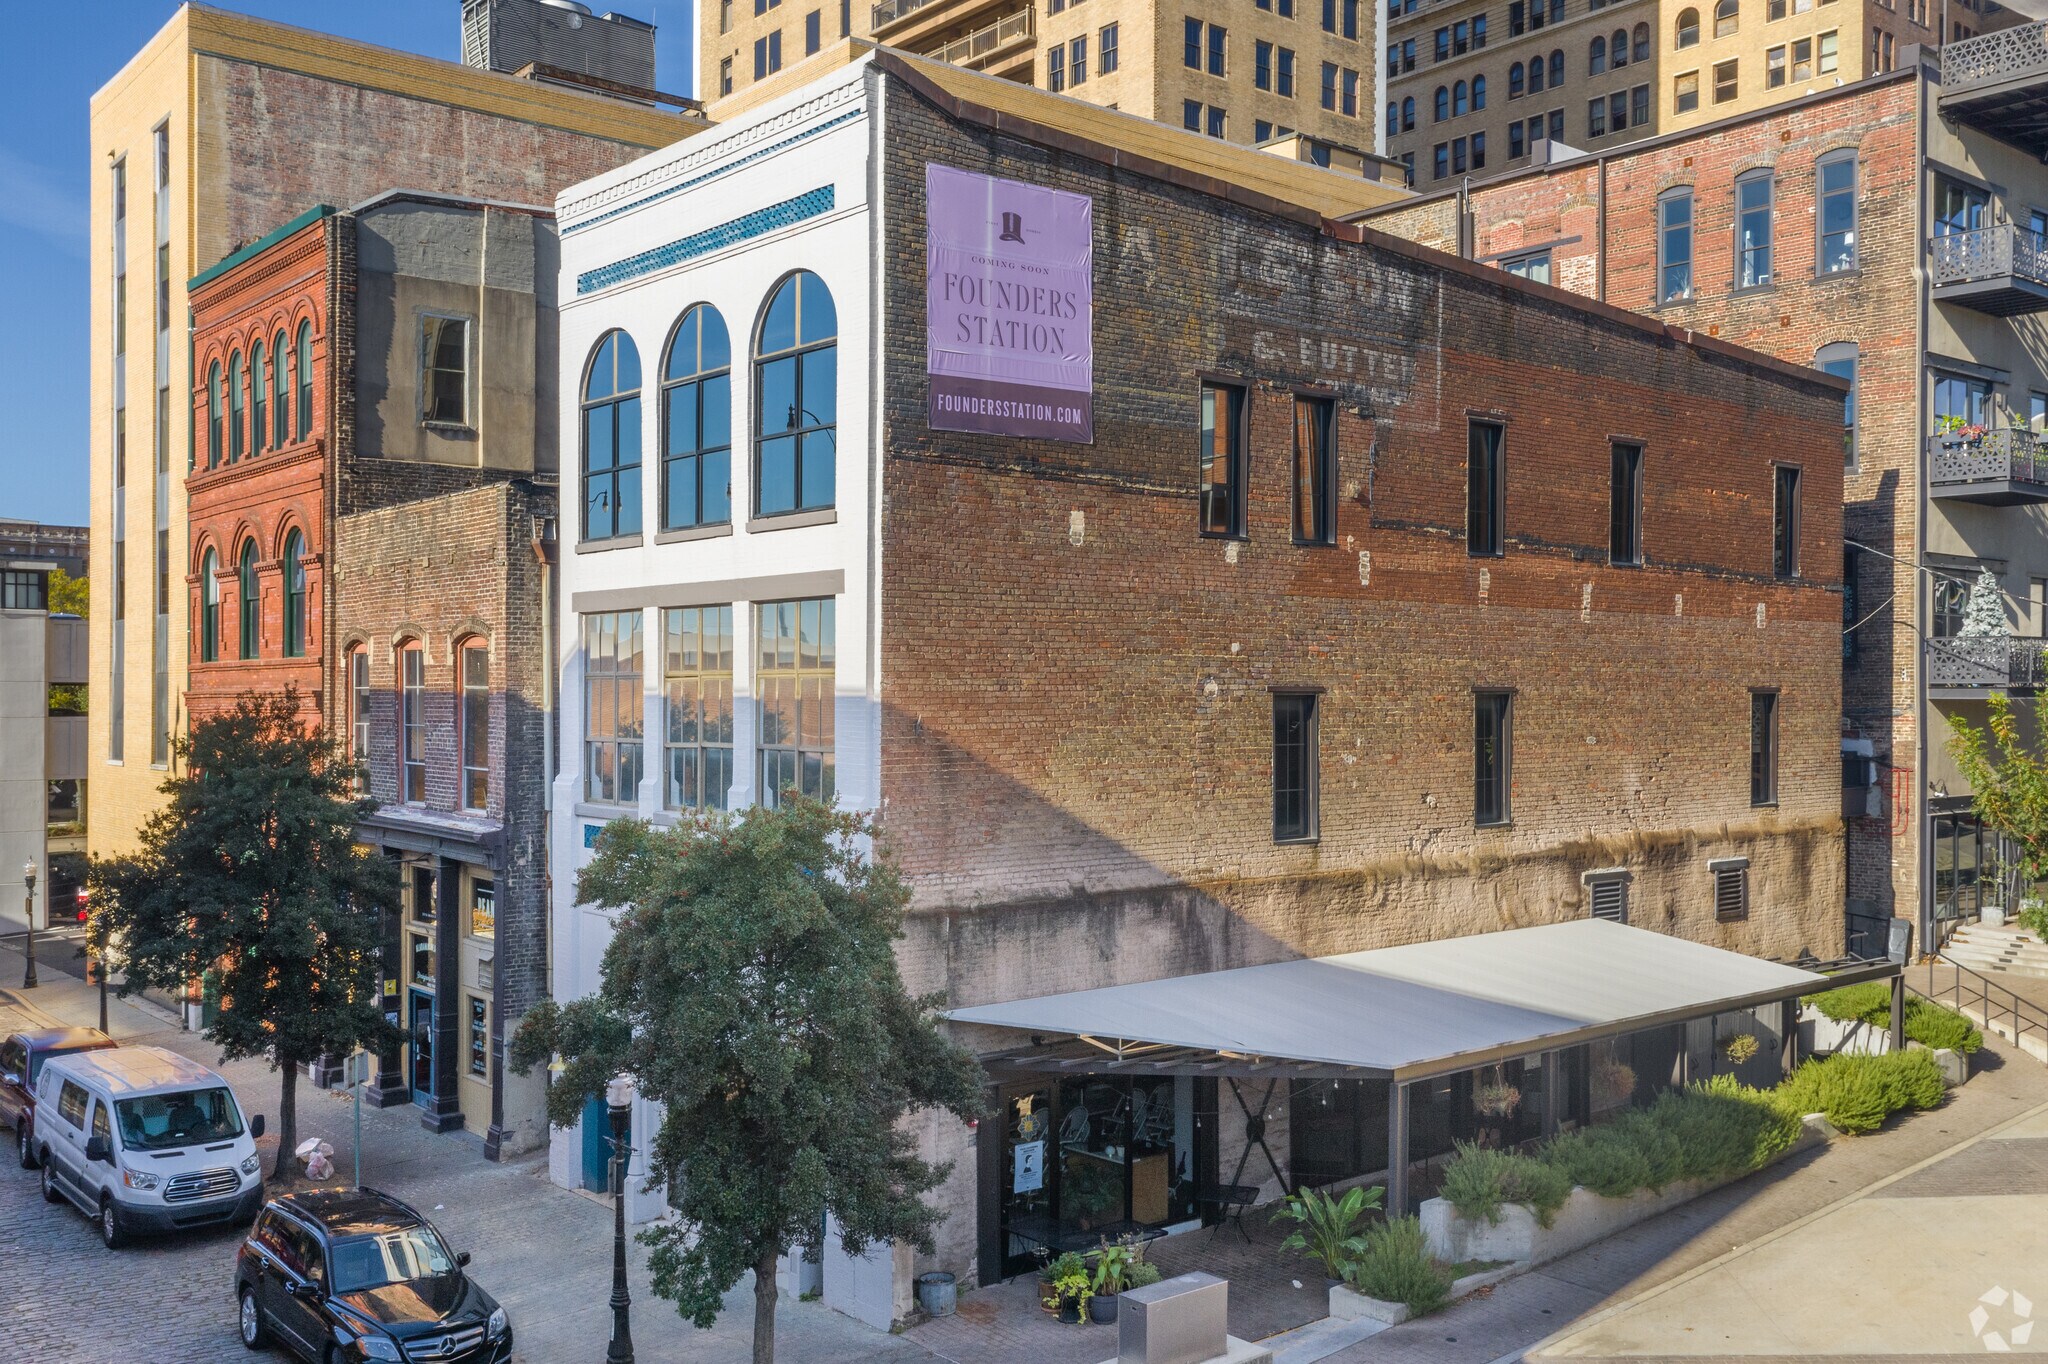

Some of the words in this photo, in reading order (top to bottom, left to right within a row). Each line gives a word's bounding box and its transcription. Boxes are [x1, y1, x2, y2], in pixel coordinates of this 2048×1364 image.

[971, 255, 1016, 270] COMING
[1020, 263, 1050, 276] SOON
[944, 272, 1077, 320] FOUNDERS
[957, 313, 1065, 354] STATION
[938, 394, 1081, 425] FOUNDERSSTATION.COM
